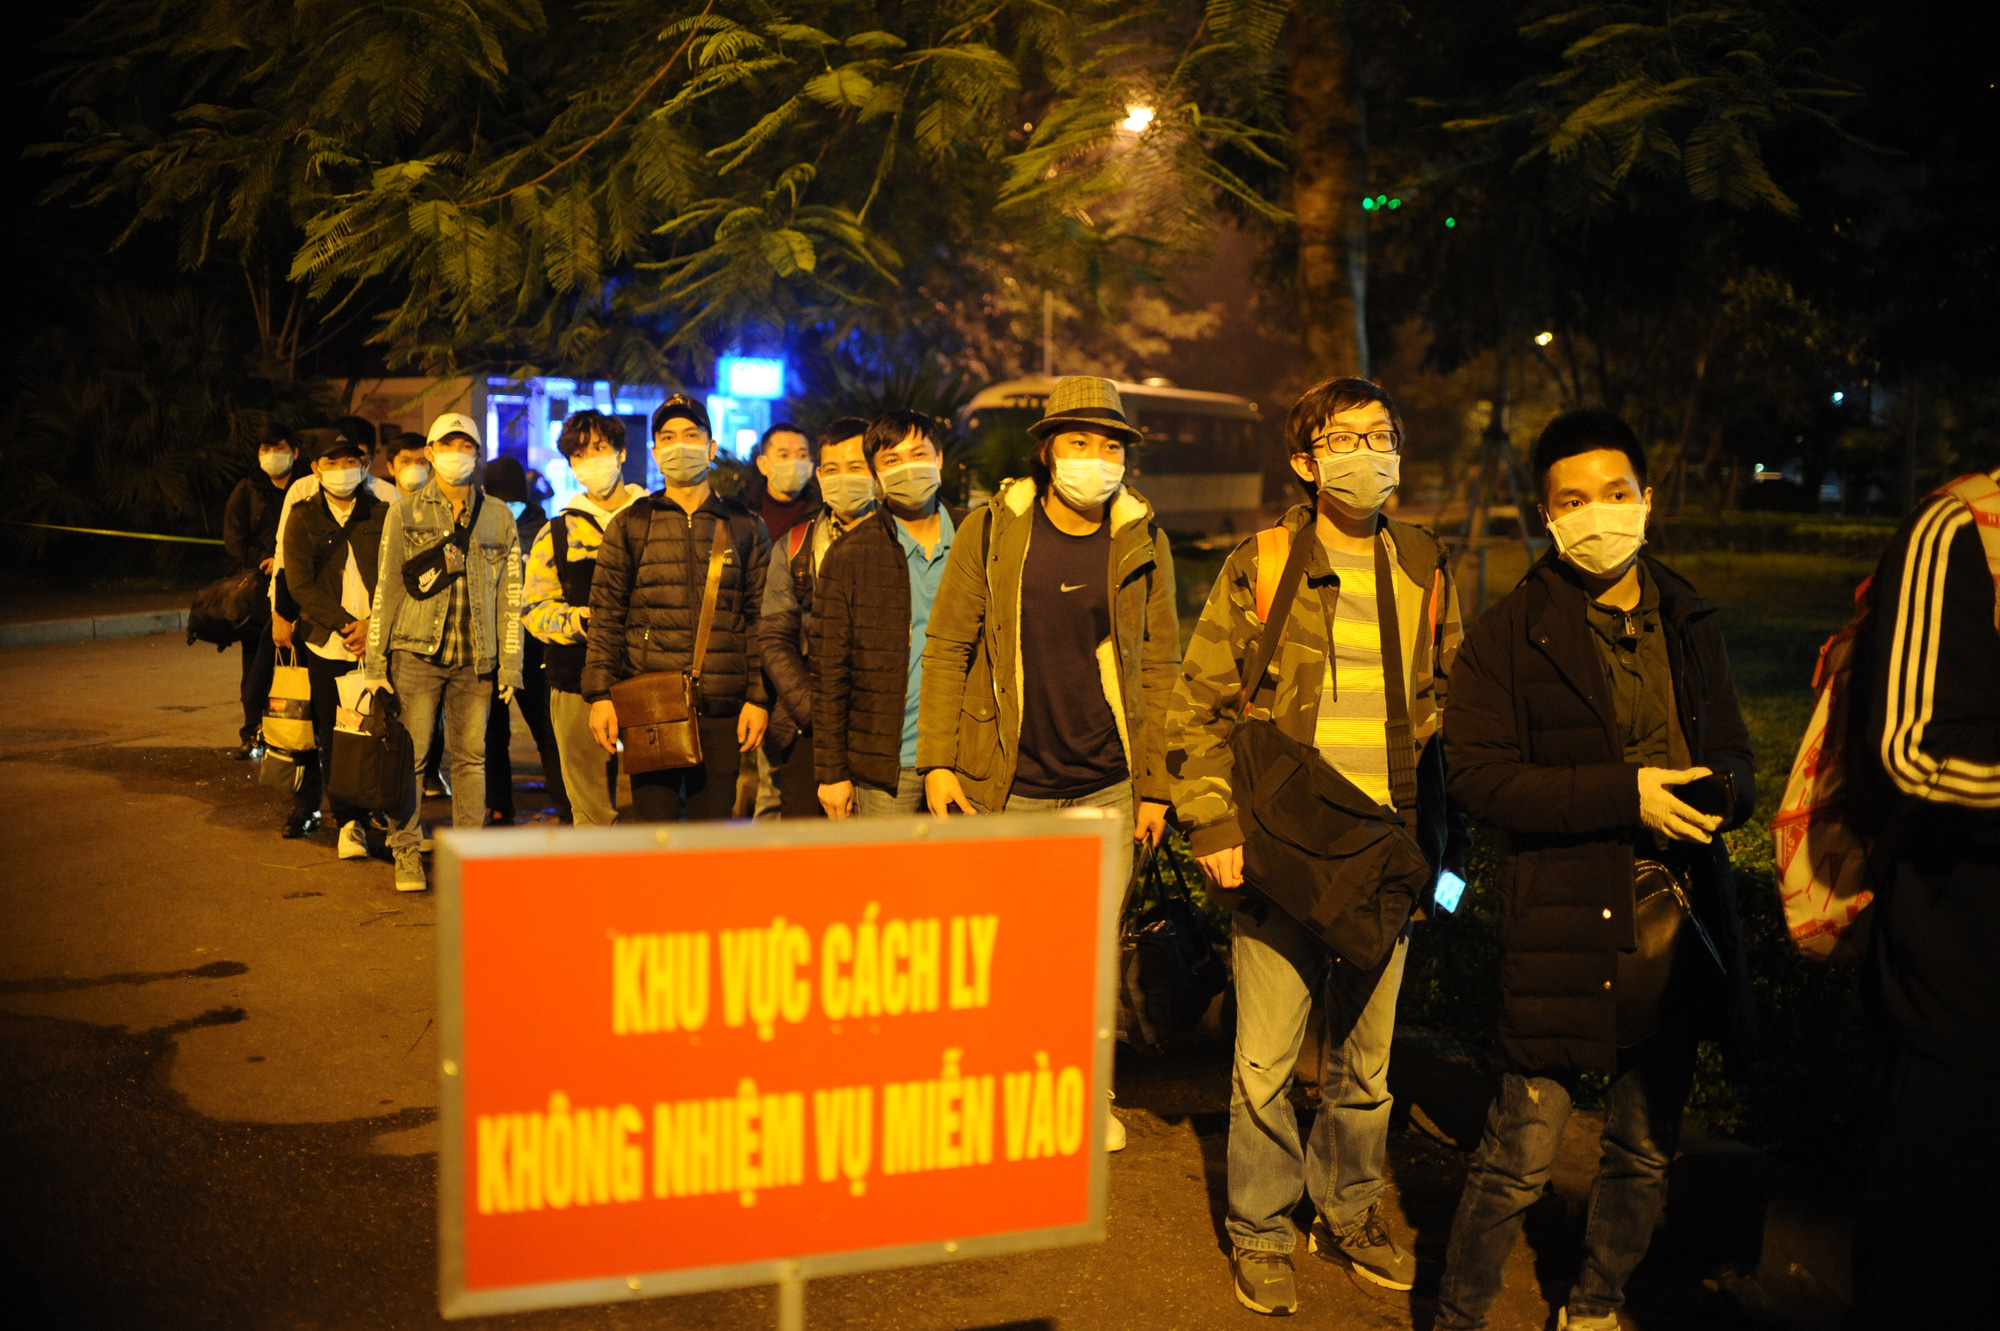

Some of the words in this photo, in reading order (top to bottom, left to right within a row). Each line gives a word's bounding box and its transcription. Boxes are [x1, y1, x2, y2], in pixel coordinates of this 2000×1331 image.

[418, 567, 436, 586] NIKE
[505, 583, 523, 607] the
[613, 931, 710, 1034] KHU
[719, 916, 811, 1041] VỰC
[821, 902, 941, 1020] CÁCH
[949, 914, 999, 1010] LY
[478, 1093, 643, 1213] KHÔNG
[654, 1078, 804, 1206] NHIỆM
[814, 1086, 873, 1196] VỤ
[882, 1048, 995, 1175] MIỄN
[1003, 1051, 1084, 1161] VÀO
